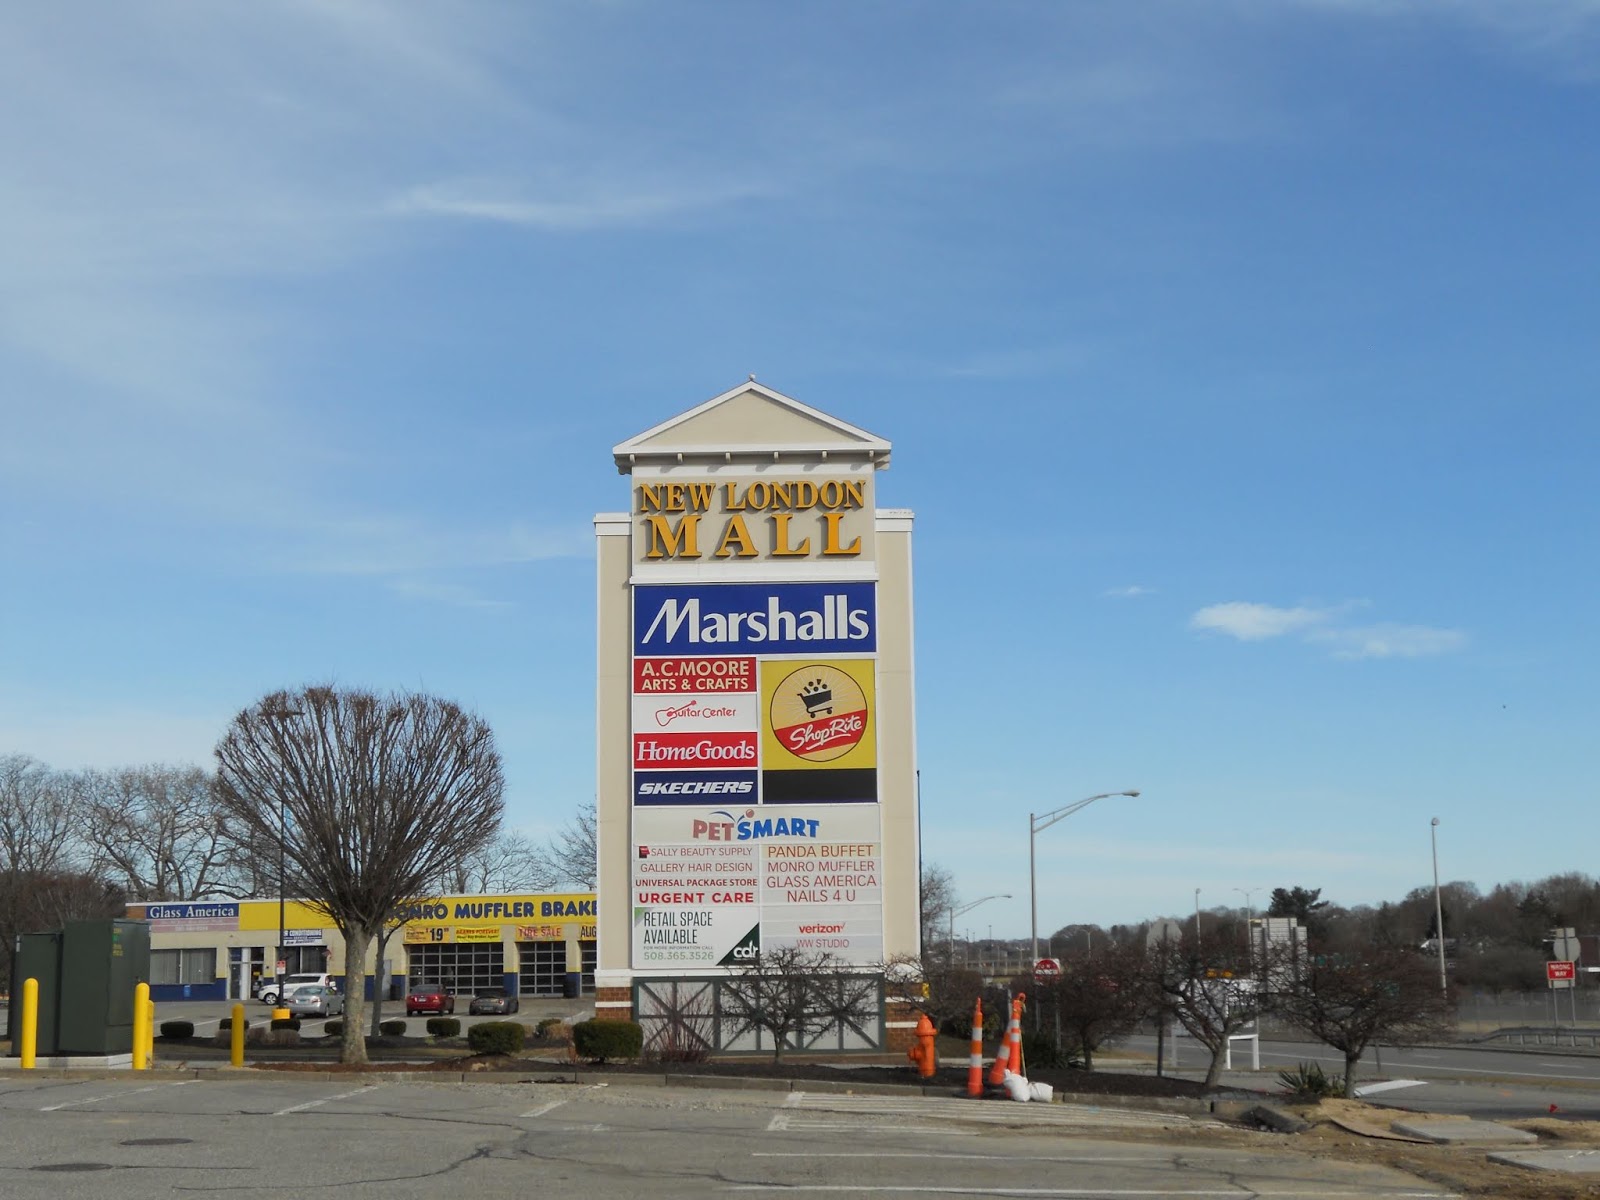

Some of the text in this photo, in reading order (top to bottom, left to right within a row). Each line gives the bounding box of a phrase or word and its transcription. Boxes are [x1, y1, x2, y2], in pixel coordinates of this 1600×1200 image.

[639, 479, 866, 512] NEW LONDON
[646, 512, 862, 558] MALL
[641, 594, 870, 643] Marshalls
[641, 660, 749, 677] A.C.MOORE
[641, 677, 749, 691] ARTS & CRAFTS
[702, 707, 736, 718] Center
[789, 714, 863, 751] ShopRite
[636, 740, 755, 761] HomeGoods
[638, 781, 754, 795] SKECHERS
[651, 847, 753, 857] SALLY BEAUTY SUPPLY
[768, 844, 874, 858] PANDA BUFFET
[640, 862, 753, 873] GALLERY HAIR DESIGN
[767, 860, 875, 873] MONRO MUFFLER
[635, 878, 758, 887] UNIVERSAL PACKAGE STORE
[766, 874, 877, 888] GLASS AMERICA
[639, 892, 754, 904] URGENT CARE
[787, 889, 856, 903] NAILS 4 U
[150, 904, 234, 919] Glass America
[386, 903, 448, 920] ONRO
[454, 902, 534, 919] MUFFLER
[644, 911, 713, 927] RETAIL SPACE
[518, 927, 562, 937] TIRE SALE
[798, 923, 841, 934] verizon
[643, 929, 698, 944] AVAILABLE
[815, 938, 850, 948] STUDIO
[643, 951, 714, 961] 508.365.3526
